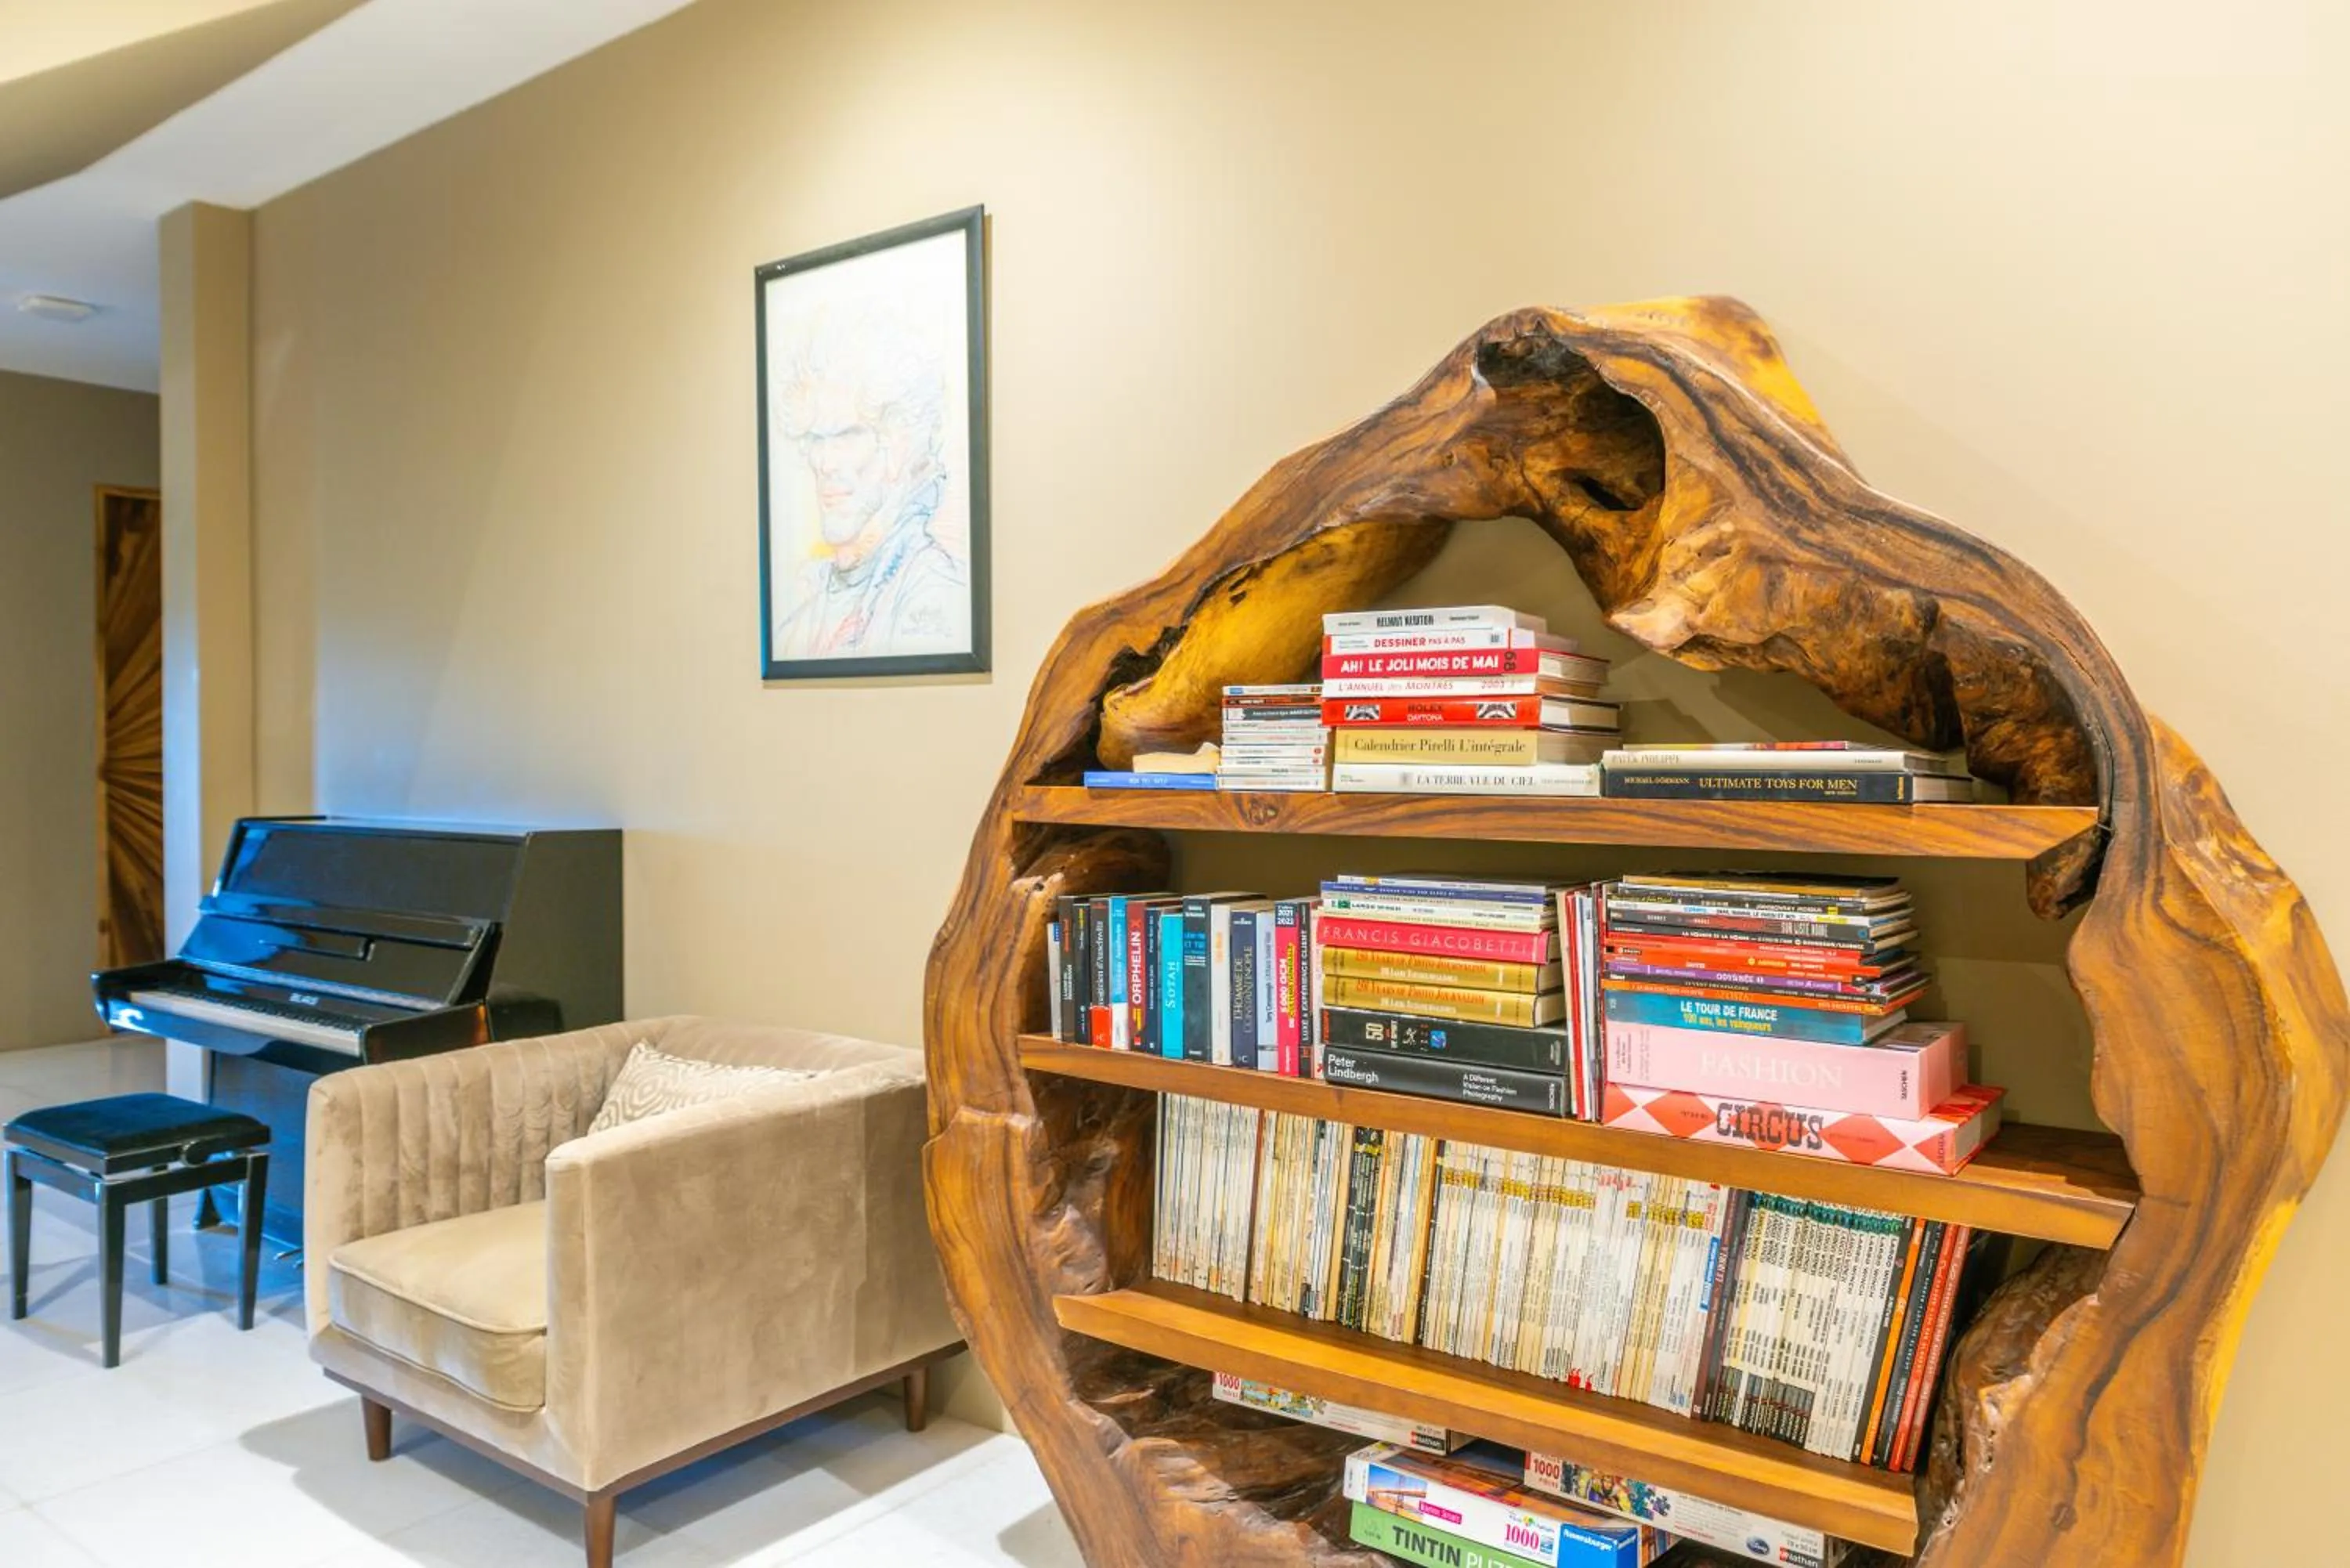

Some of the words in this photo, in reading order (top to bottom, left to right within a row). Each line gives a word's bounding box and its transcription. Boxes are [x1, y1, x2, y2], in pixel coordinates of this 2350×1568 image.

[1374, 635, 1426, 648] DESSINER
[1340, 660, 1363, 674] AH!
[1368, 660, 1383, 672] LE
[1386, 659, 1414, 671] JOLI
[1415, 658, 1448, 671] MOIS
[1452, 657, 1469, 670] DE
[1472, 656, 1499, 669] MAI
[1354, 738, 1415, 752] Calendrier
[1419, 739, 1455, 752] Pirelli
[1459, 739, 1526, 756] L'intégrale
[1699, 777, 1762, 789] ULTIMATE
[1766, 778, 1797, 789] TOYS
[1799, 779, 1824, 789] FOR
[1827, 779, 1858, 790] MEN
[1322, 927, 1400, 944] FRANCIS
[1410, 933, 1528, 955] GIACOBETTI
[1131, 931, 1141, 1005] ORPHELIN
[1680, 1001, 1692, 1013] LE
[1694, 1003, 1721, 1016] TOUR
[1723, 1003, 1737, 1017] DE
[1738, 1005, 1777, 1021] FRANCE
[1328, 1054, 1356, 1068] Peter
[1698, 1050, 1844, 1089] FASHION
[1328, 1066, 1379, 1083] Lindbergh
[1716, 1102, 1824, 1151] CIRCUS
[1218, 1371, 1240, 1390] 1000
[1533, 1458, 1560, 1479] 1000
[1392, 1525, 1461, 1567] TINTIN
[1504, 1523, 1540, 1551] 1000
